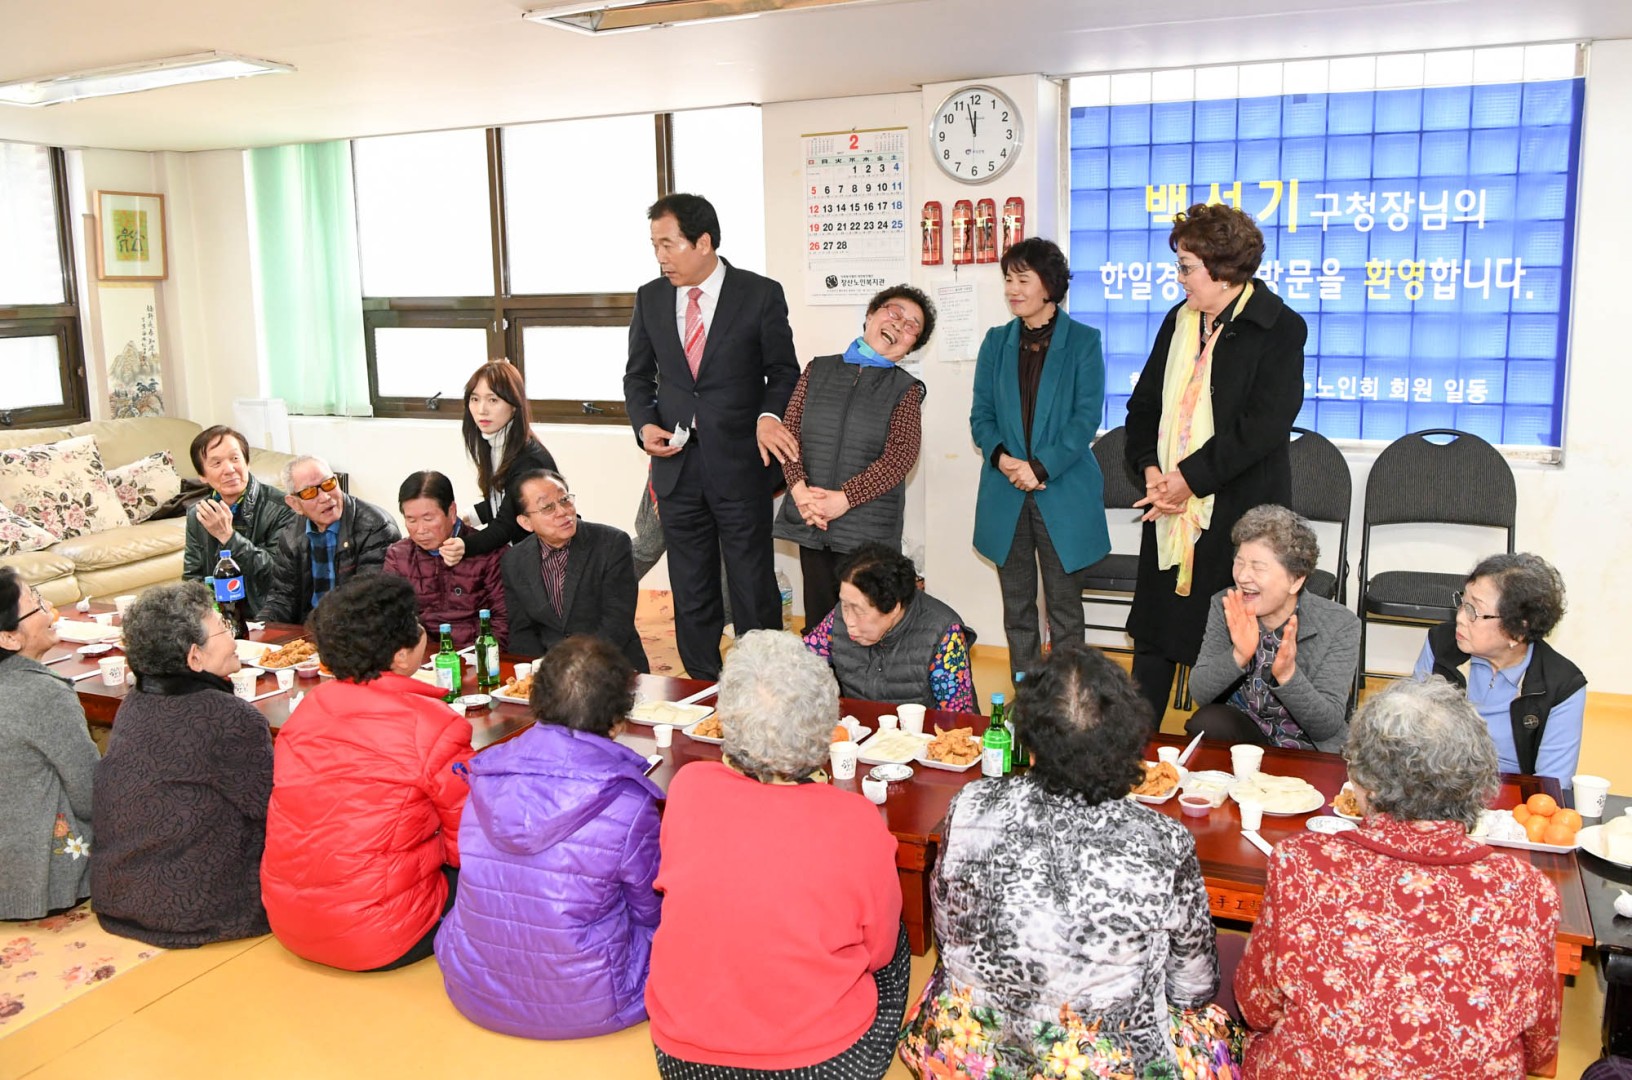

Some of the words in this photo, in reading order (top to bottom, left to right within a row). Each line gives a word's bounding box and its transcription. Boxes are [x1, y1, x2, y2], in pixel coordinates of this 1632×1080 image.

[970, 95, 981, 105] 12
[991, 99, 996, 110] 1
[954, 101, 964, 111] 11
[943, 113, 954, 124] 10
[1001, 111, 1009, 122] 2
[939, 131, 946, 142] 9
[1006, 129, 1013, 140] 3
[849, 134, 860, 150] 2
[943, 149, 950, 160] 8
[1000, 148, 1007, 158] 4
[852, 165, 857, 174] 1
[865, 164, 872, 174] 2
[879, 163, 886, 173] 3
[893, 162, 900, 172] 4
[955, 162, 961, 172] 7
[971, 166, 978, 176] 6
[988, 161, 995, 171] 5
[811, 186, 817, 195] 5
[824, 185, 831, 195] 6
[838, 185, 844, 193] 7
[851, 184, 858, 193] 8
[865, 183, 872, 192] 9
[877, 182, 888, 192] 10
[892, 181, 902, 191] 11
[809, 205, 820, 214] 12
[822, 204, 833, 213] 13
[836, 203, 847, 212] 14
[850, 202, 860, 212] 15
[863, 202, 874, 211] 16
[877, 201, 888, 211] 17
[891, 200, 903, 210] 18
[1310, 188, 1486, 232] 구청장님의
[809, 223, 820, 232] 19
[822, 222, 834, 232] 20
[836, 222, 847, 231] 21
[849, 221, 861, 231] 22
[863, 221, 875, 230] 23
[877, 220, 889, 230] 24
[891, 219, 903, 229] 25
[809, 241, 820, 251] 26
[823, 241, 834, 250] 27
[836, 240, 848, 250] 28
[1258, 258, 1345, 300] 방문을
[1364, 256, 1534, 301] 환영합니다.
[1389, 377, 1432, 402] 회원
[1444, 378, 1489, 404] 일동
